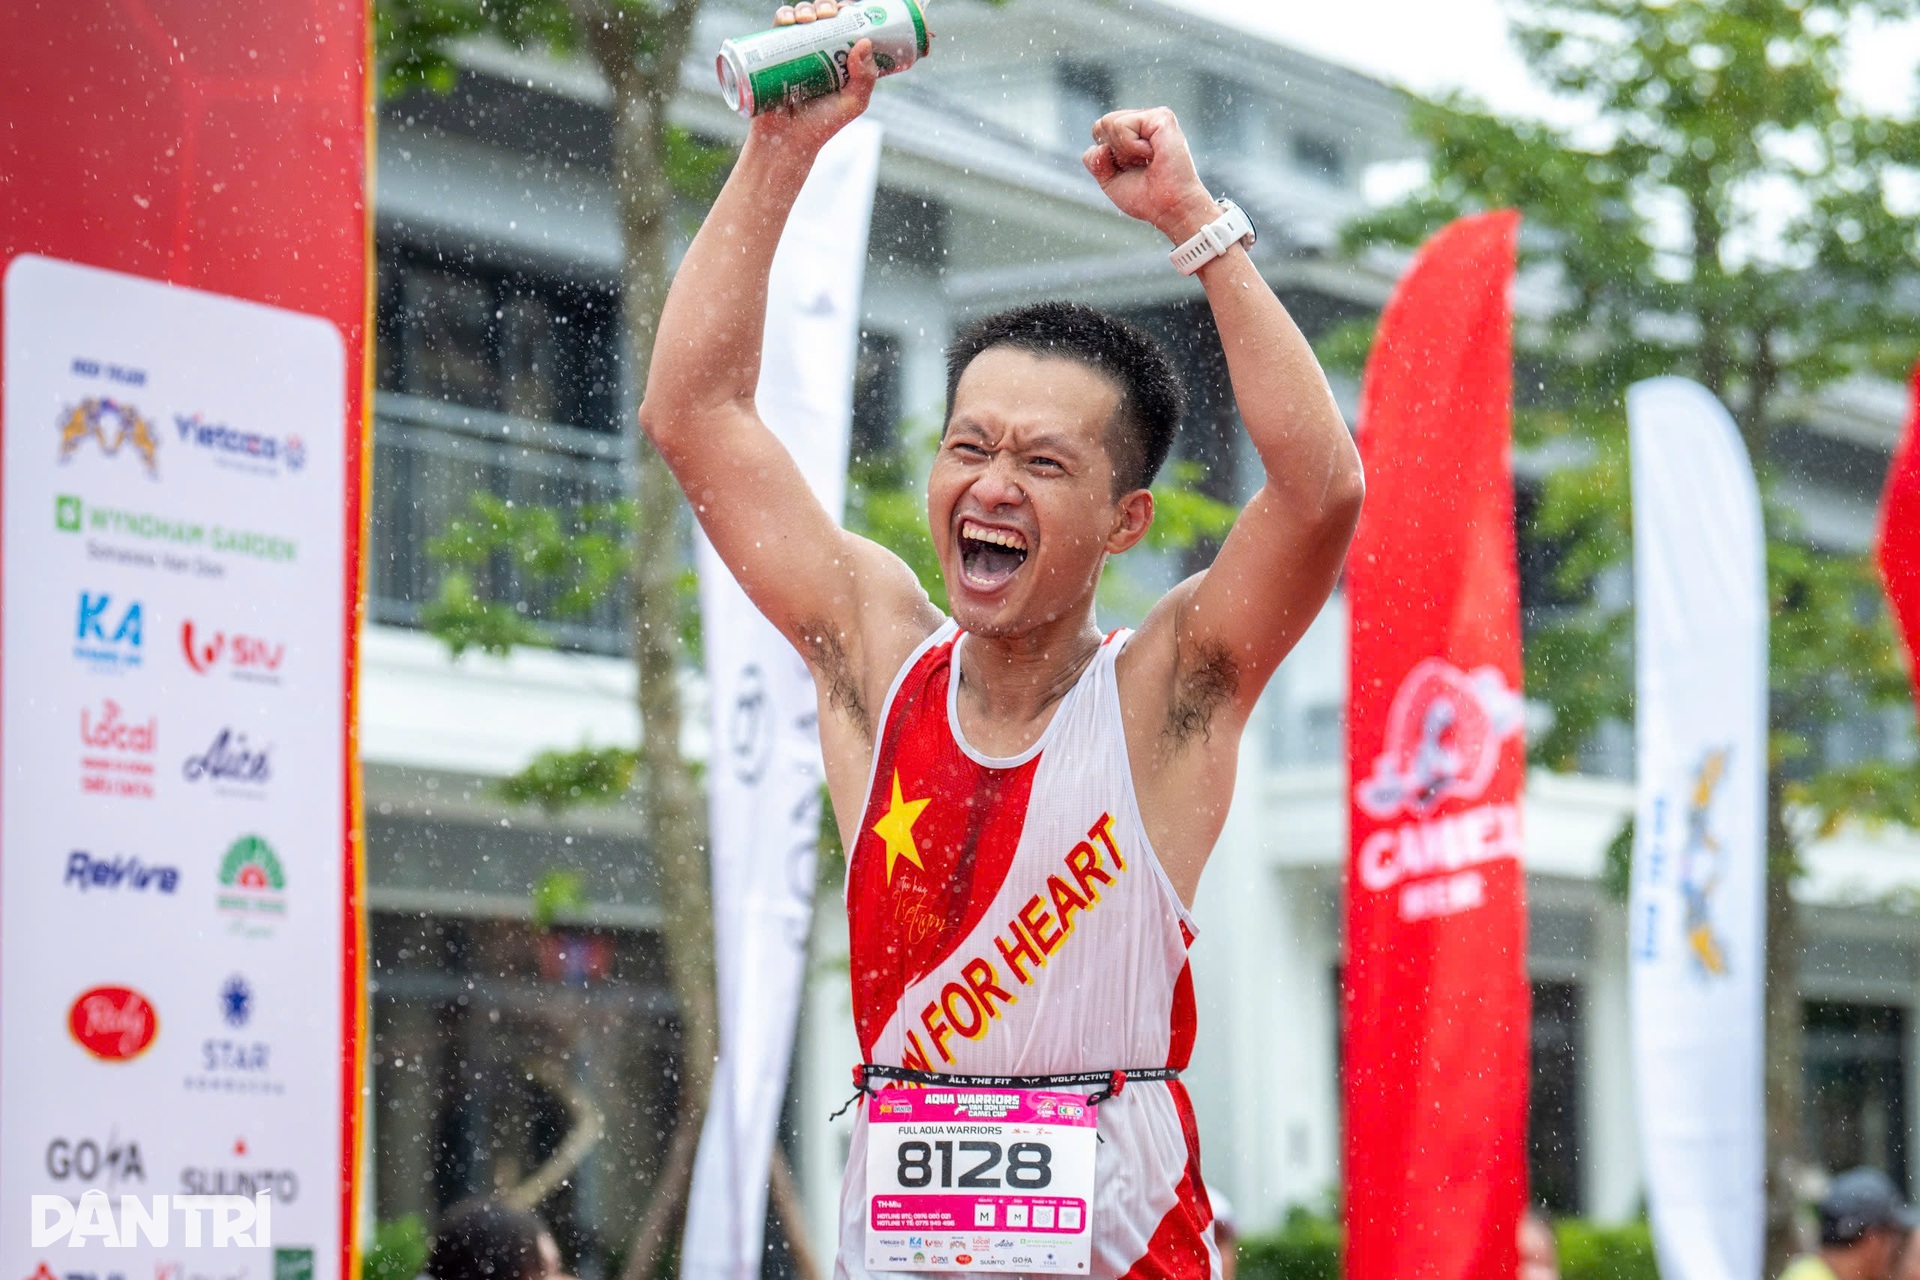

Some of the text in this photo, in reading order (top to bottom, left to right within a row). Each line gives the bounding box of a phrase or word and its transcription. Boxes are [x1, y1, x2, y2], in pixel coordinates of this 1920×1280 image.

[76, 589, 143, 648] KA
[920, 811, 1127, 1067] FOR HEART
[202, 1038, 271, 1071] STAR
[949, 1077, 967, 1085] ALL
[970, 1077, 991, 1085] THE
[1078, 1073, 1110, 1081] ACTIVE
[925, 1094, 1020, 1105] AQUA WARRIORS
[898, 1126, 1002, 1135] FULL AQUA WARRIORS
[896, 1140, 1052, 1189] 8128
[980, 1212, 989, 1221] M
